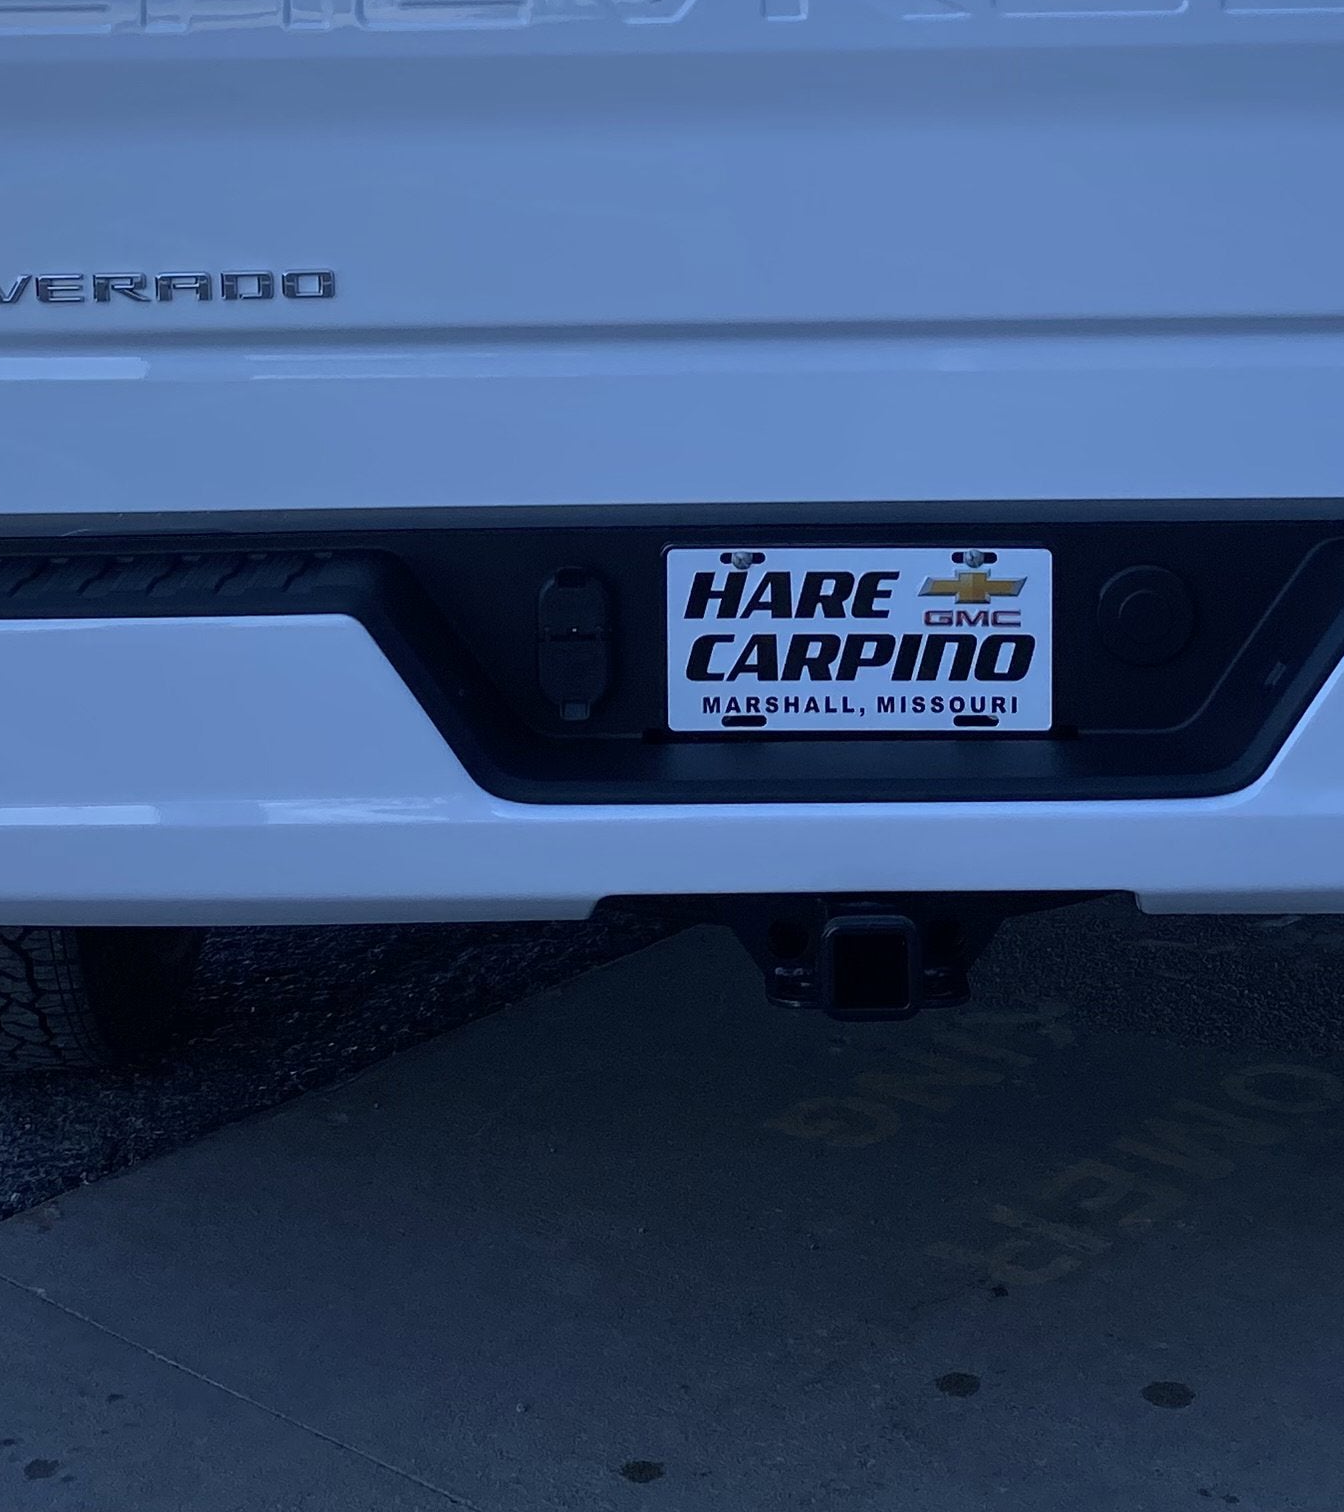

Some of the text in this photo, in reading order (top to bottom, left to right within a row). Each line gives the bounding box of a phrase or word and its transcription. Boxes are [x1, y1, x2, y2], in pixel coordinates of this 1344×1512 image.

[683, 570, 901, 620] HARE
[923, 609, 1023, 627] GMC
[685, 633, 1036, 683] CARPINO
[702, 696, 1019, 717] MARSHALL, MISSOURI
